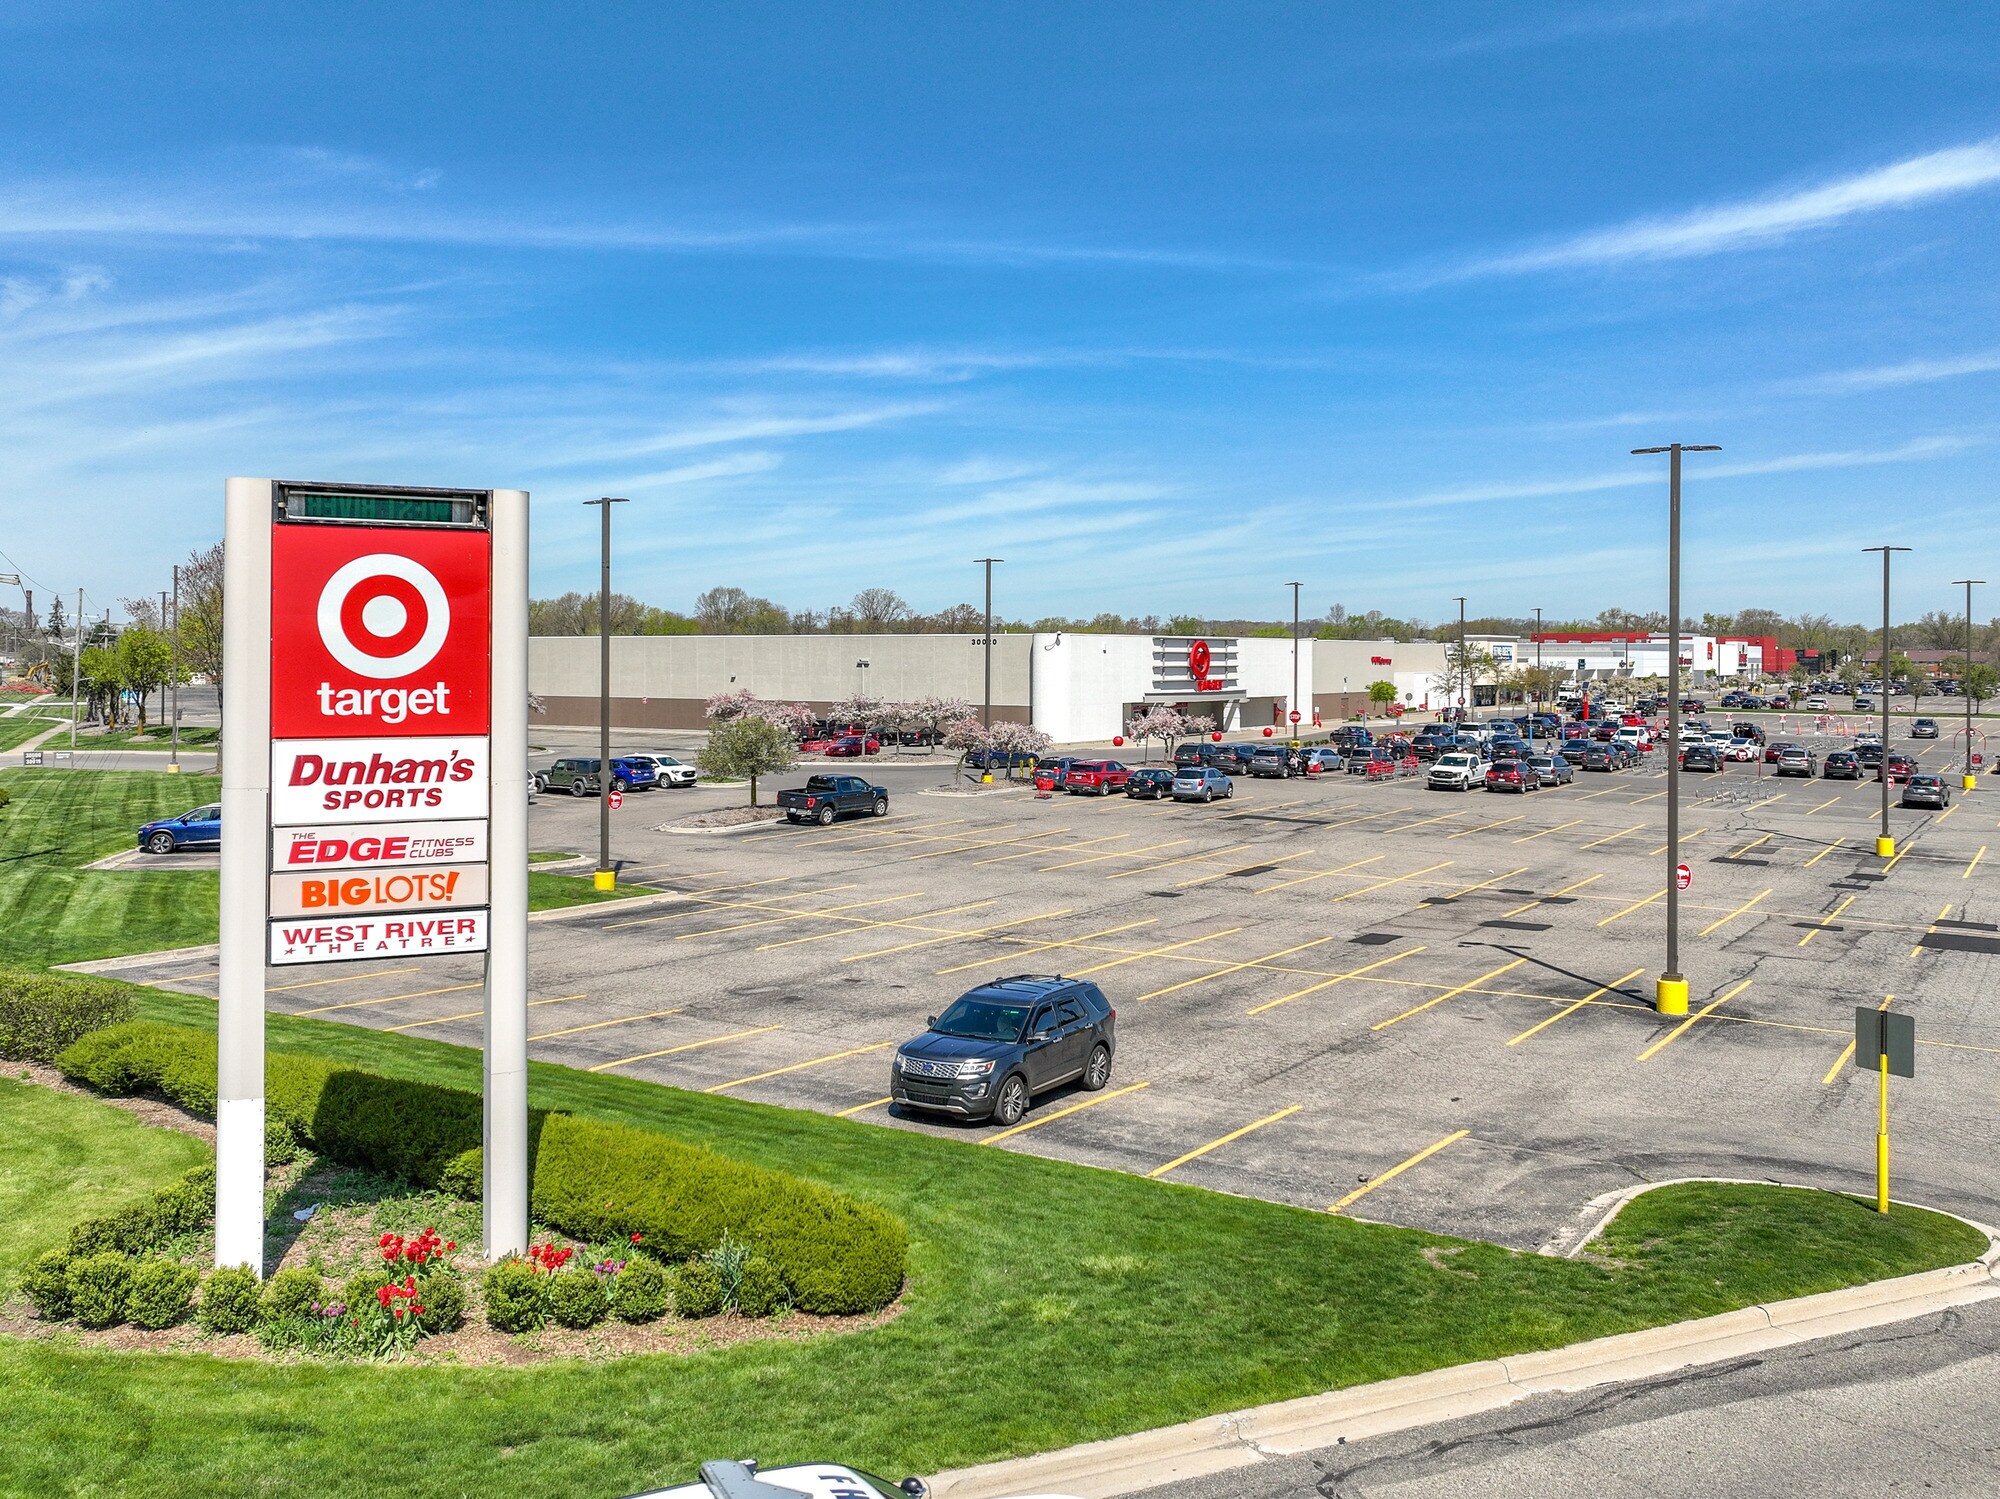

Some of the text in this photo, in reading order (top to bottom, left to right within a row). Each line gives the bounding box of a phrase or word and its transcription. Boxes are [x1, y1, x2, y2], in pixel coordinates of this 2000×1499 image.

[317, 682, 450, 724] target
[288, 750, 475, 787] Dunham's
[323, 788, 443, 810] SPORTS
[292, 832, 316, 840] THE
[288, 836, 475, 864] EDGE FITNESS
[409, 848, 455, 858] CLUBS
[283, 918, 476, 945] WEST RIVER
[305, 936, 455, 955] THEATRE
